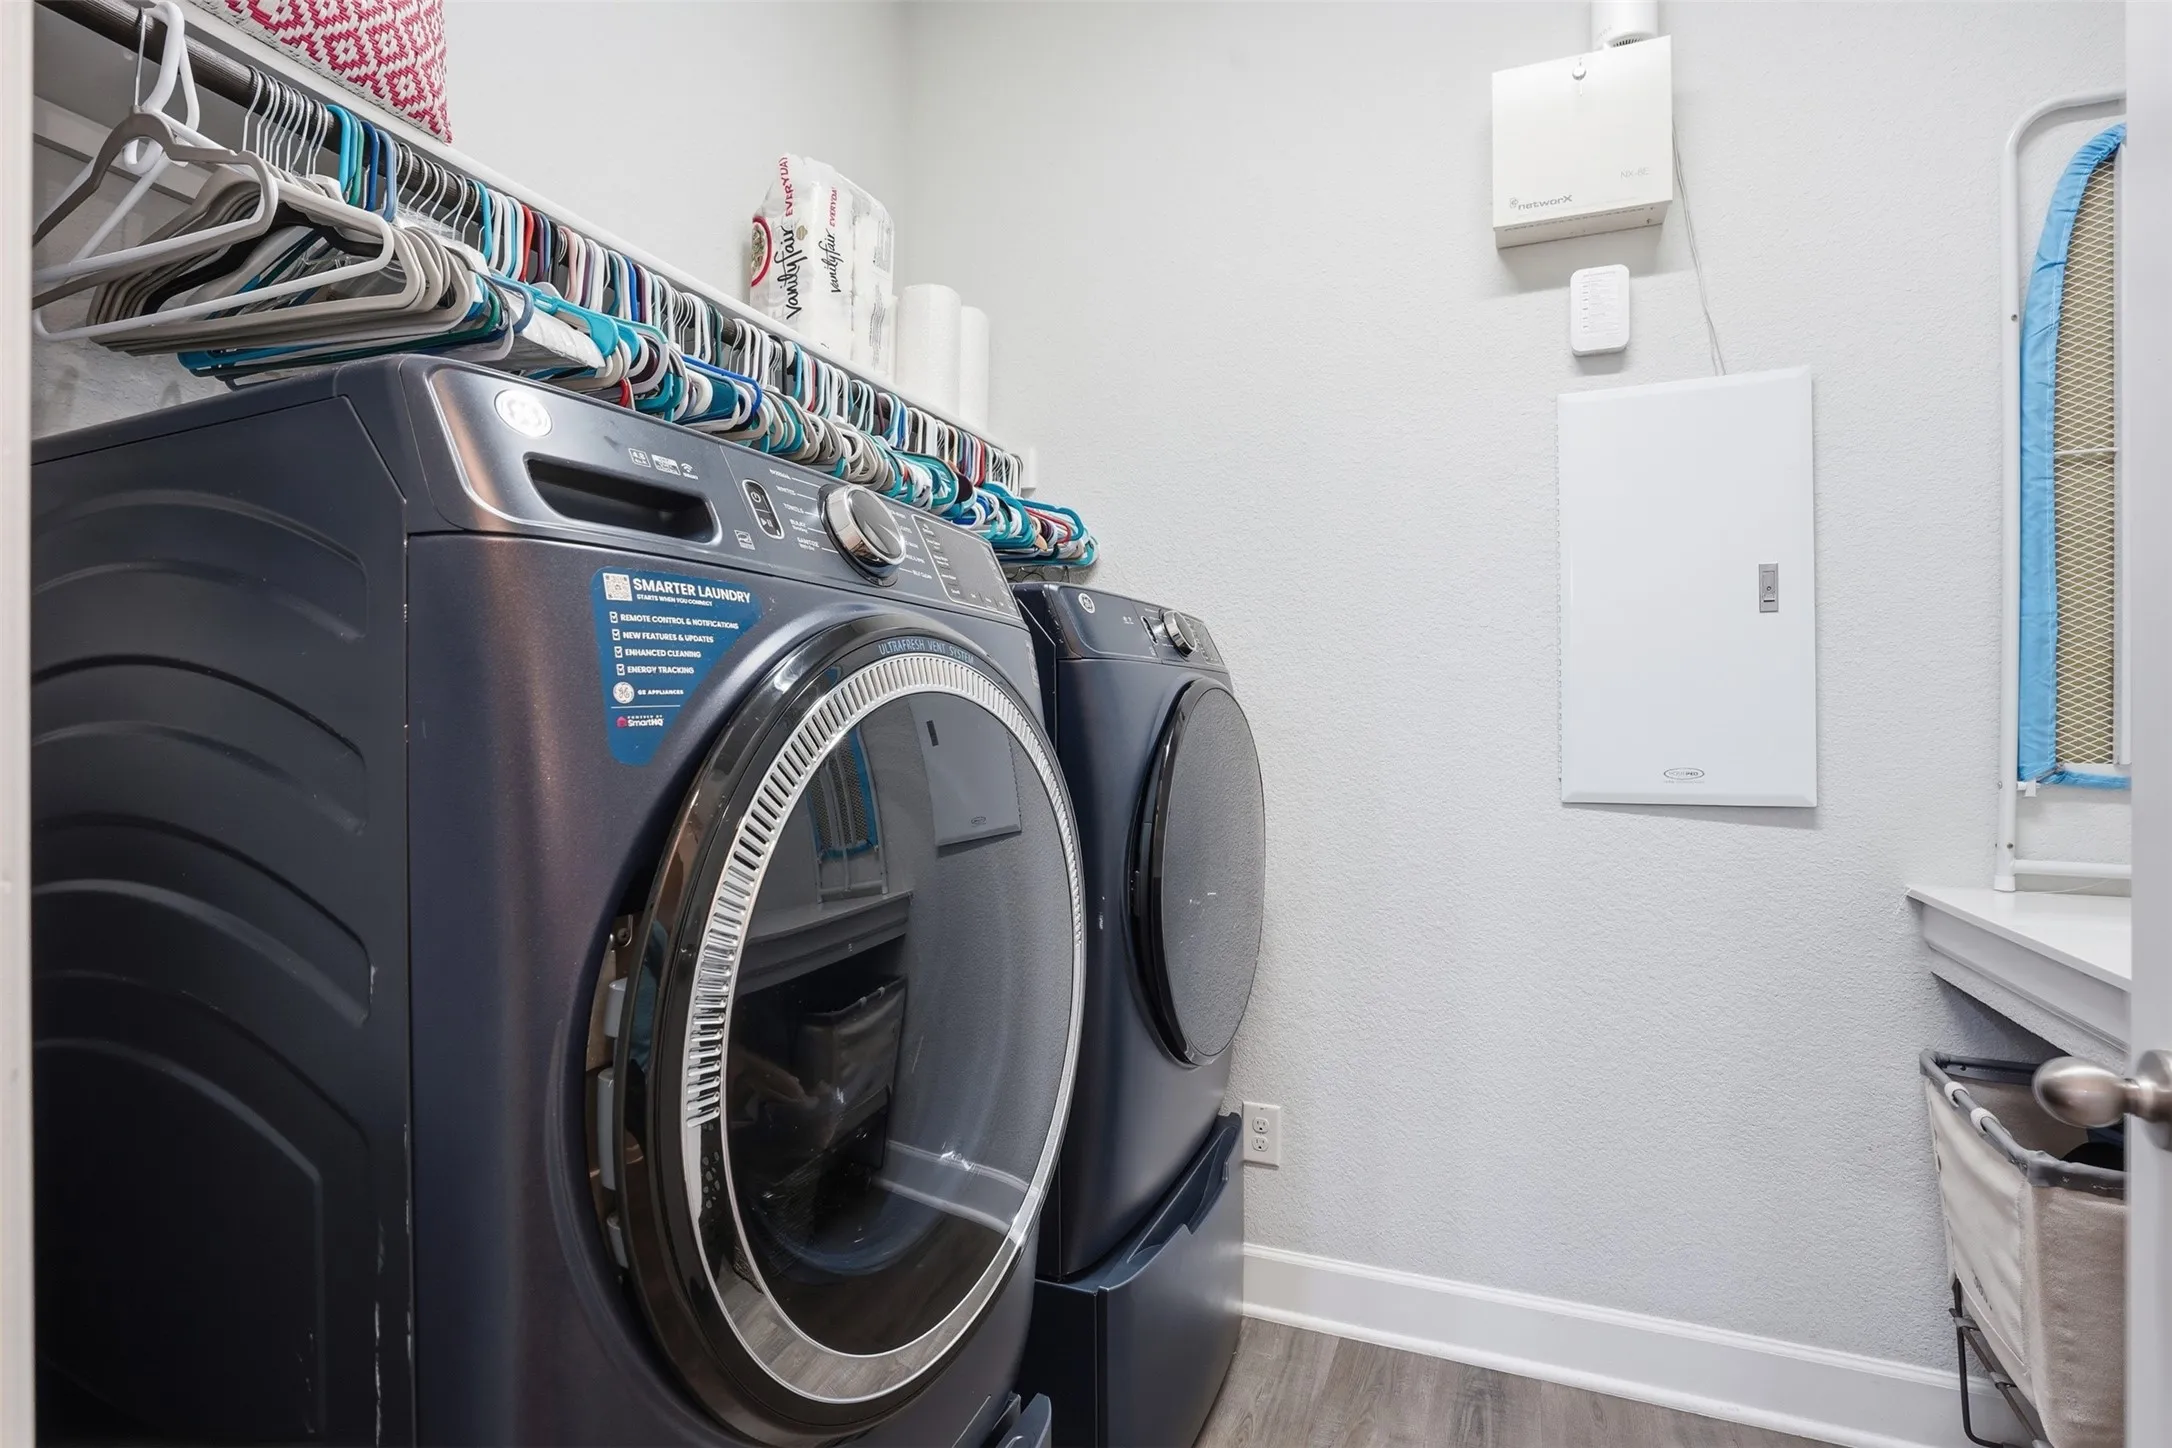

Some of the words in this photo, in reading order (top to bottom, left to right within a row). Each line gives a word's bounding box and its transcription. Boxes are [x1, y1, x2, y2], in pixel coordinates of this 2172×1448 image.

[633, 578, 696, 597] SMARTER
[698, 585, 750, 603] LAUNDRY
[620, 613, 651, 623] REMOTE
[652, 616, 685, 625] CONTROL
[692, 618, 739, 629] NOTIFICATIONS
[622, 631, 642, 640] NEW
[642, 632, 677, 641] FEATURES
[684, 634, 714, 643] UPDATES
[625, 648, 667, 657] ENHANCED
[667, 649, 702, 659] CLEANING
[878, 639, 926, 655] ULTRAFRESH
[927, 640, 946, 654] VENT
[948, 645, 974, 665] SYSTEM
[627, 665, 657, 674] ENERGY
[658, 666, 695, 675] TRACKING
[627, 718, 664, 727] SmartHQ
